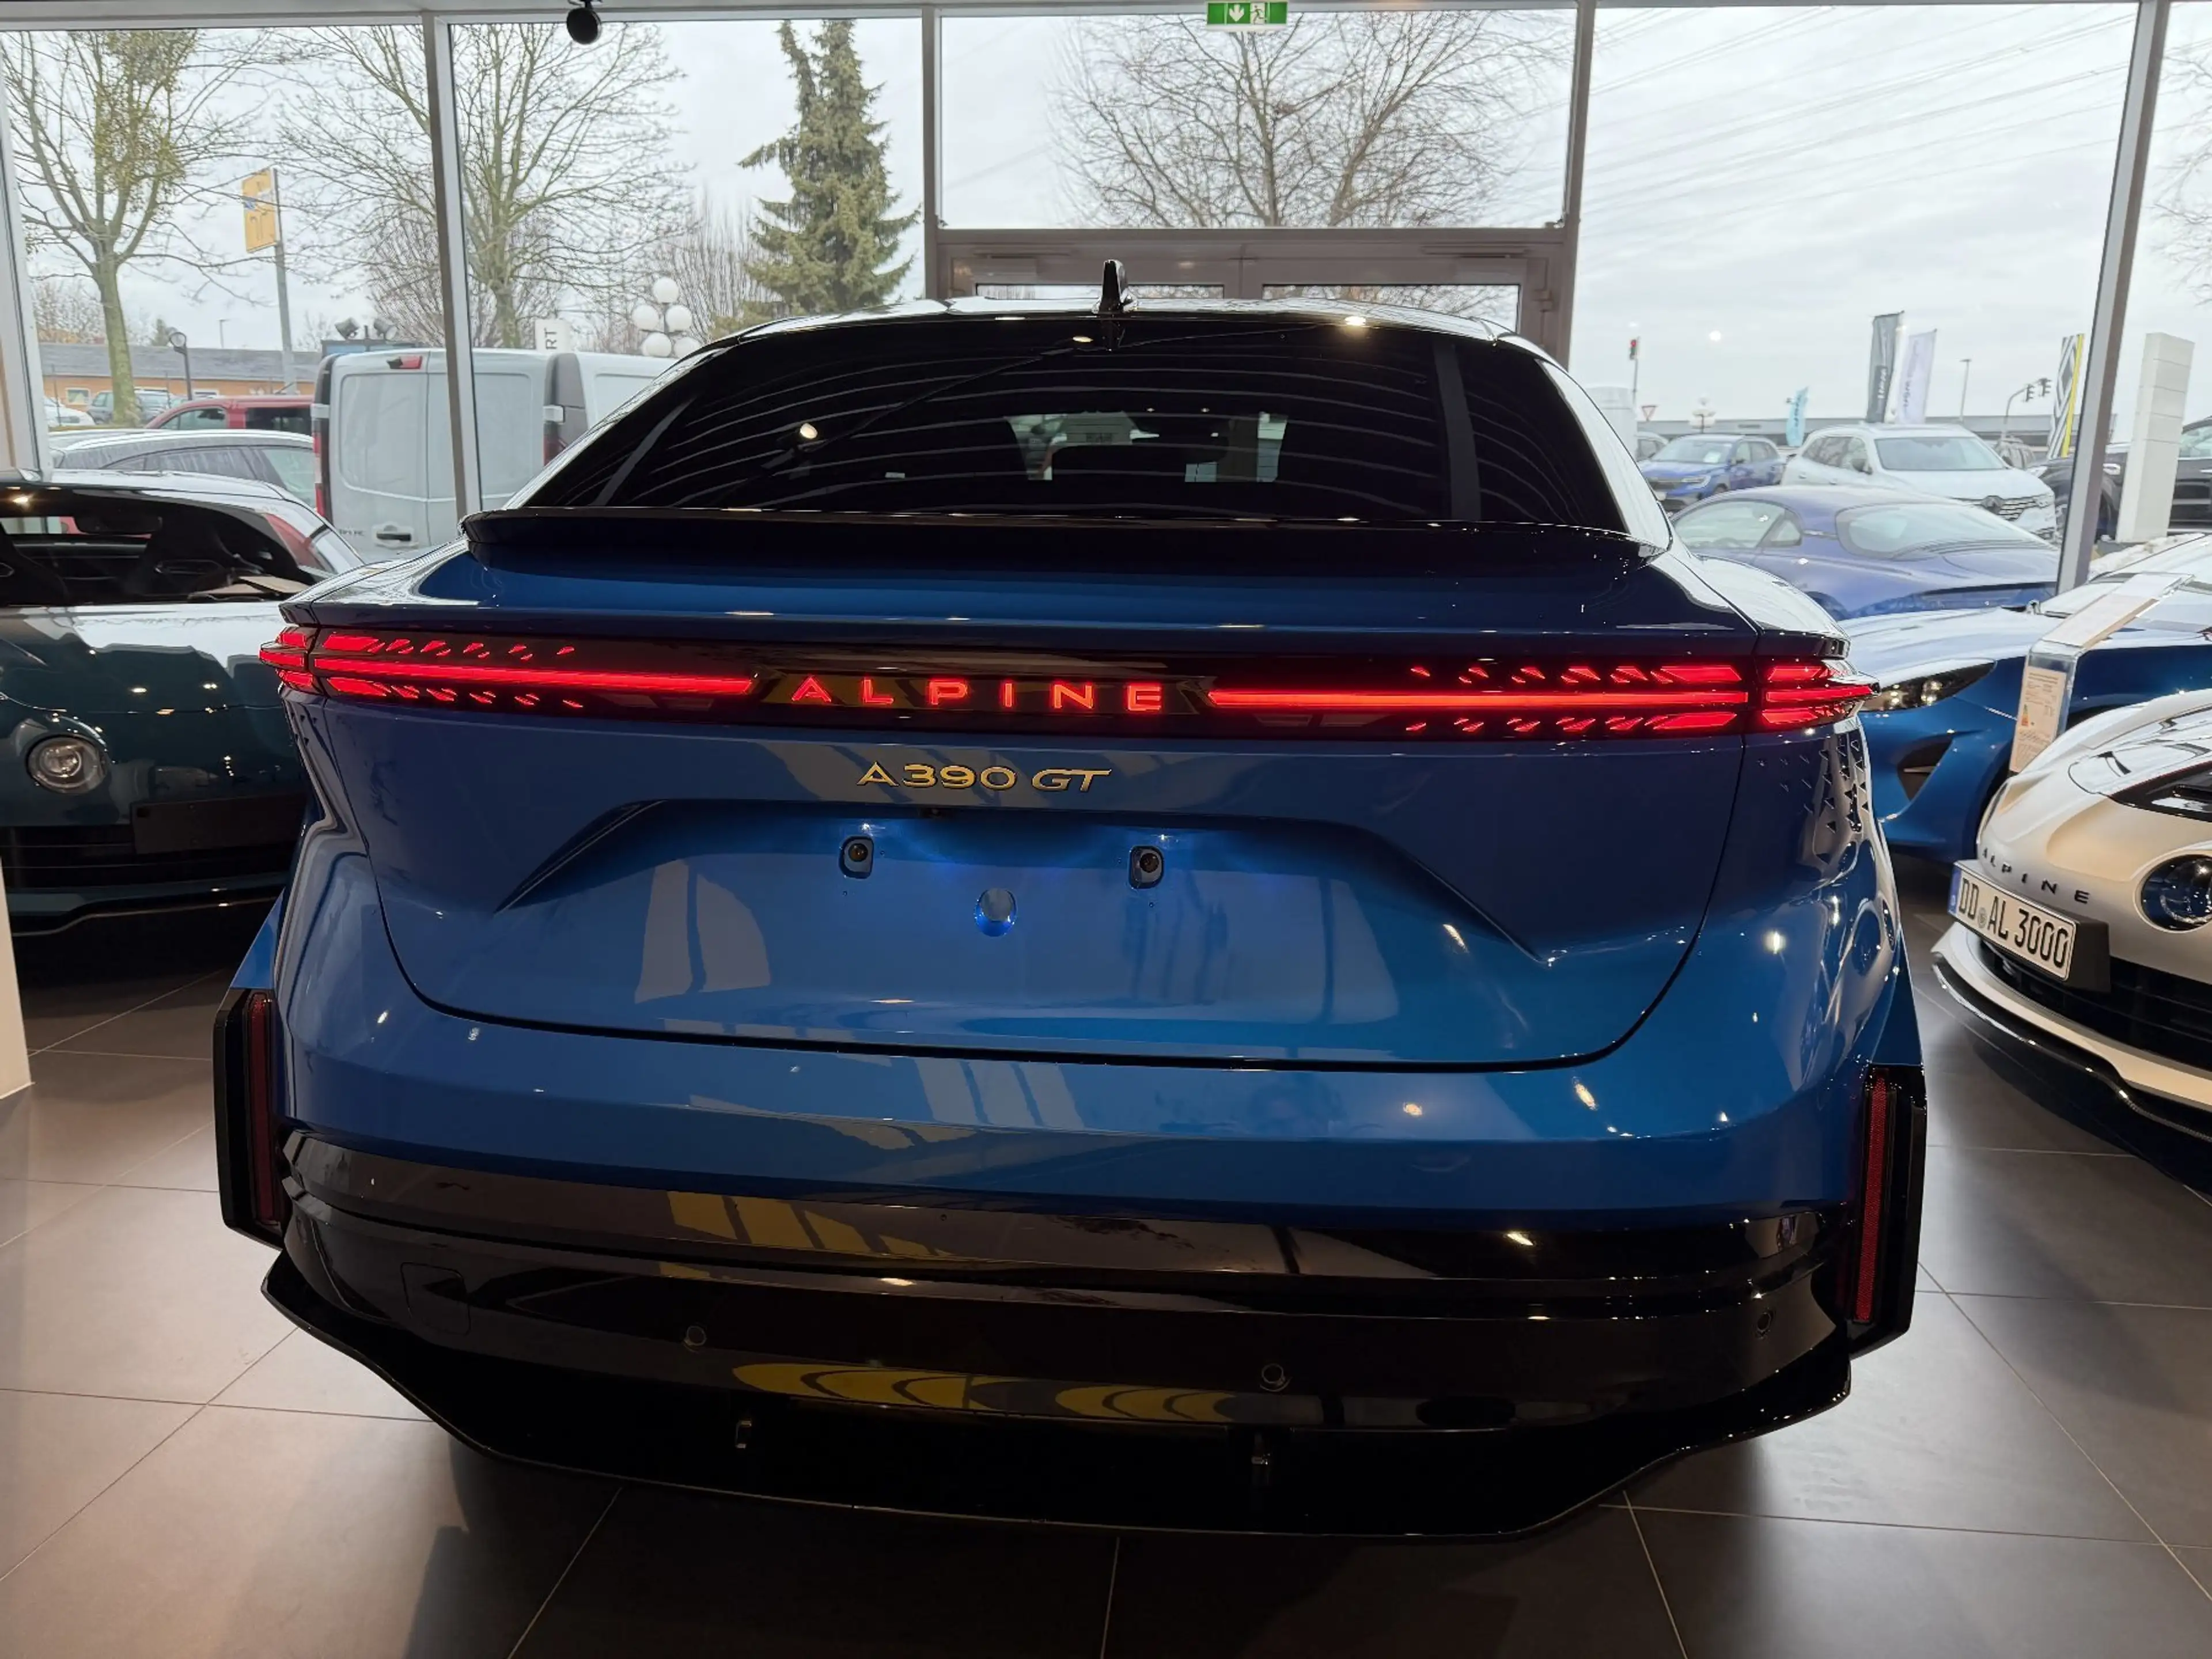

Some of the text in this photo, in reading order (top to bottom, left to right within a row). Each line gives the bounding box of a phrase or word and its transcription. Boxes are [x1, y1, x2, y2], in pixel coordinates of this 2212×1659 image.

[791, 677, 1162, 711] ALPINE
[857, 762, 1112, 791] A390 GT
[1982, 848, 2090, 904] ALPINE
[1959, 877, 2069, 969] DD AL 3000
